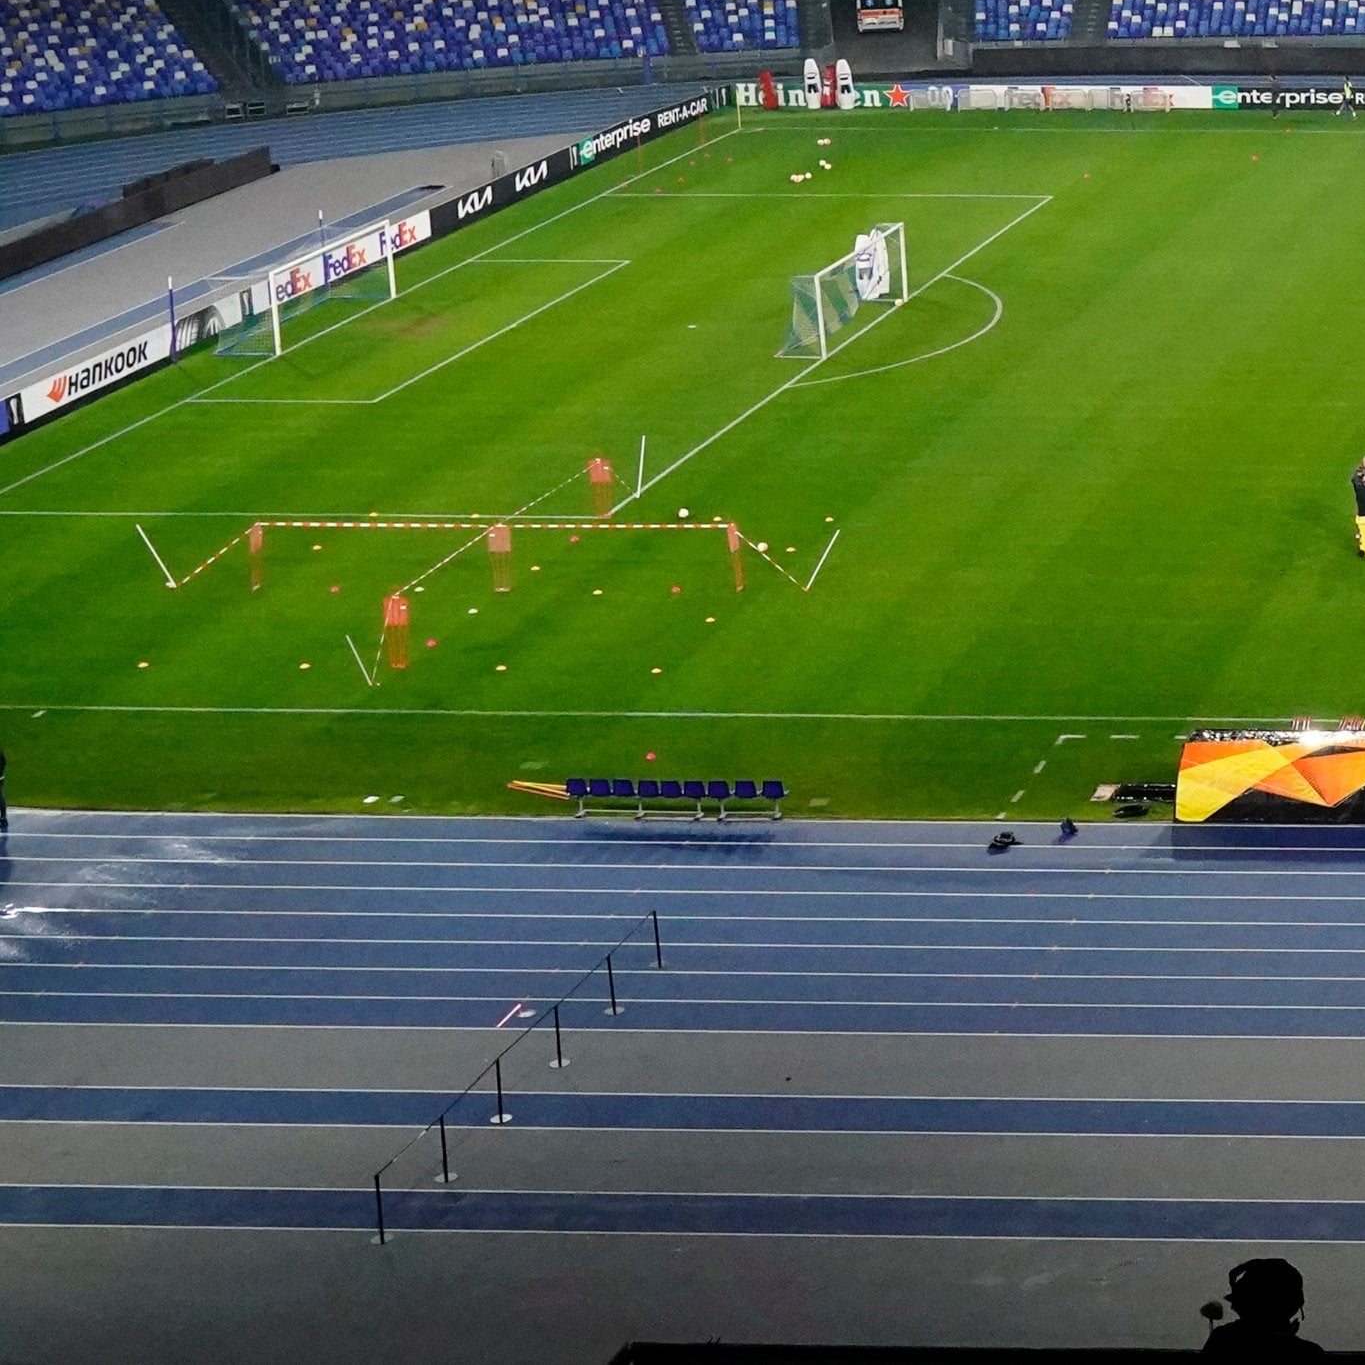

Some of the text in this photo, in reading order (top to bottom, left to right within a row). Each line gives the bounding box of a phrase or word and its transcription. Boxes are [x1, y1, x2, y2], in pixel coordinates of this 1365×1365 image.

[581, 97, 708, 160] enterprise RENT-A-CAR
[326, 243, 367, 284] FedEx
